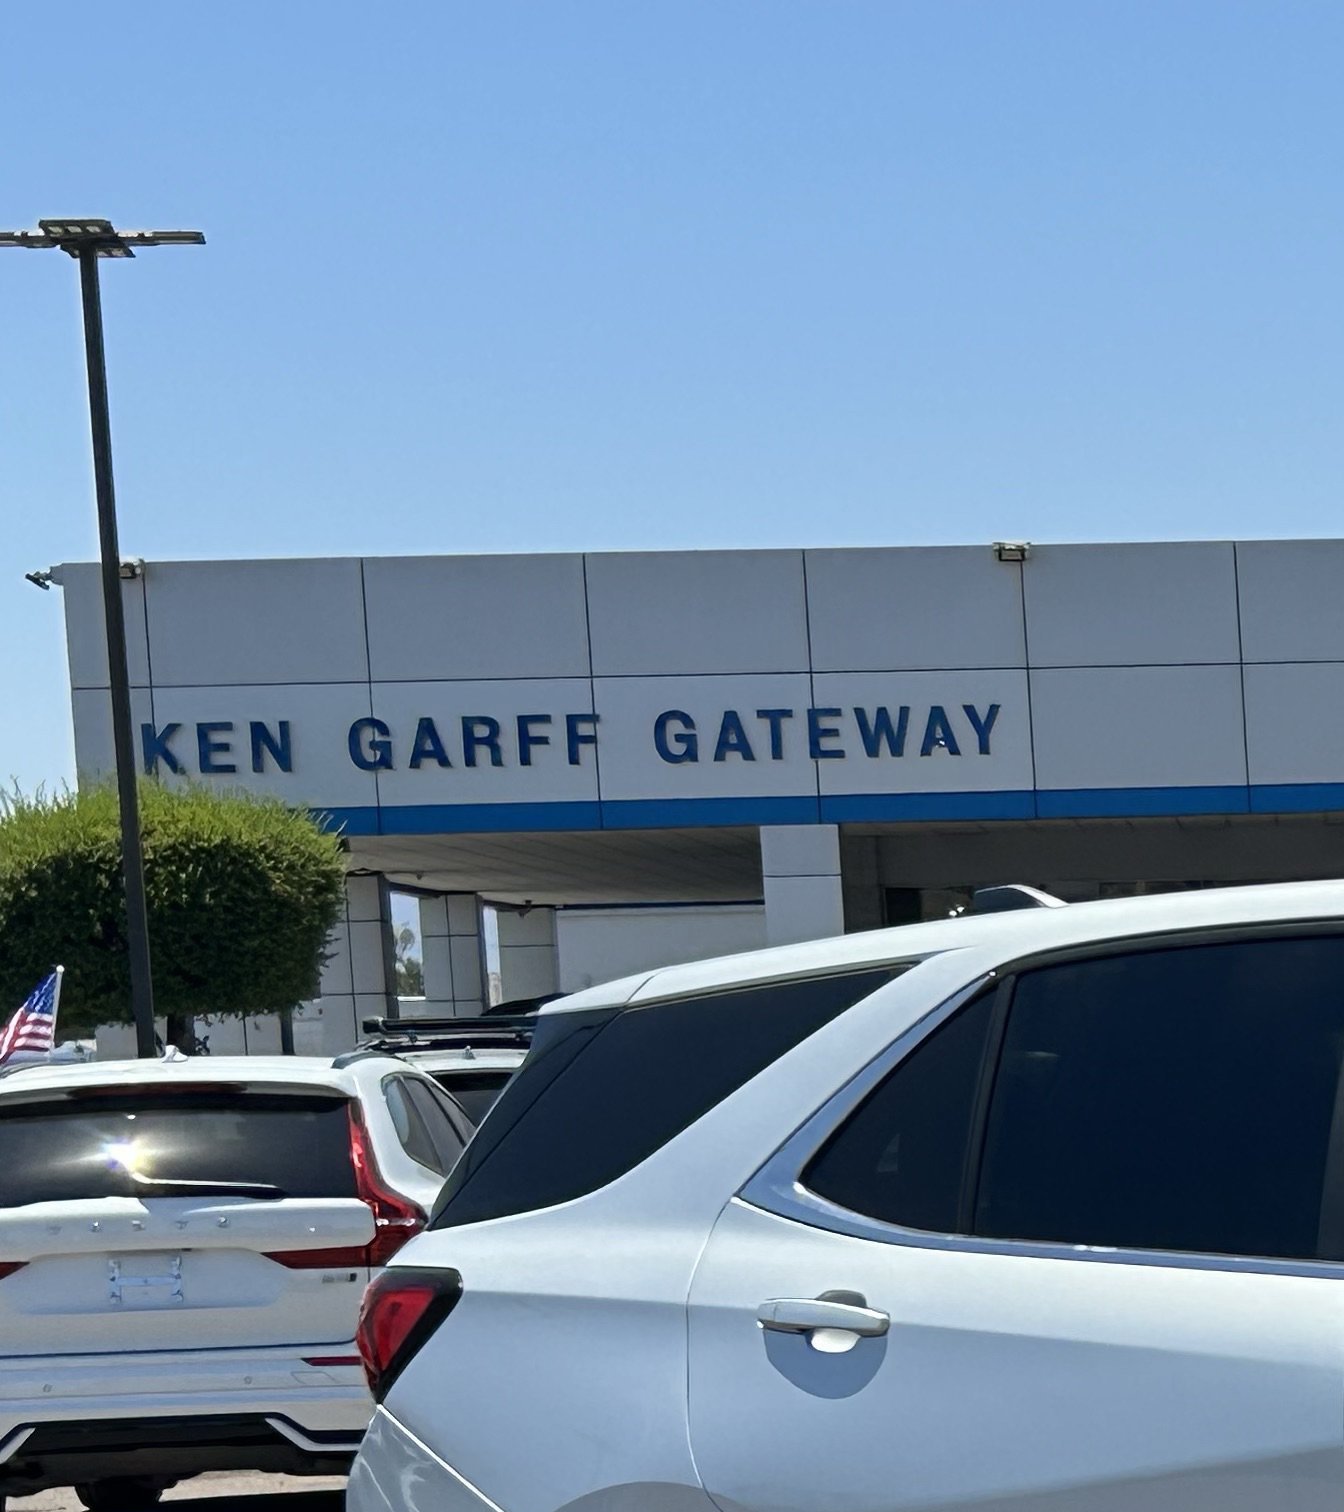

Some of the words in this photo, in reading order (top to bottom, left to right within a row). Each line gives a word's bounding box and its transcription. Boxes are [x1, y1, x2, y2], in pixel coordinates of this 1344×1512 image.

[141, 719, 293, 776] KEN
[347, 713, 600, 771] GARFF
[653, 703, 1001, 764] GATEWAY
